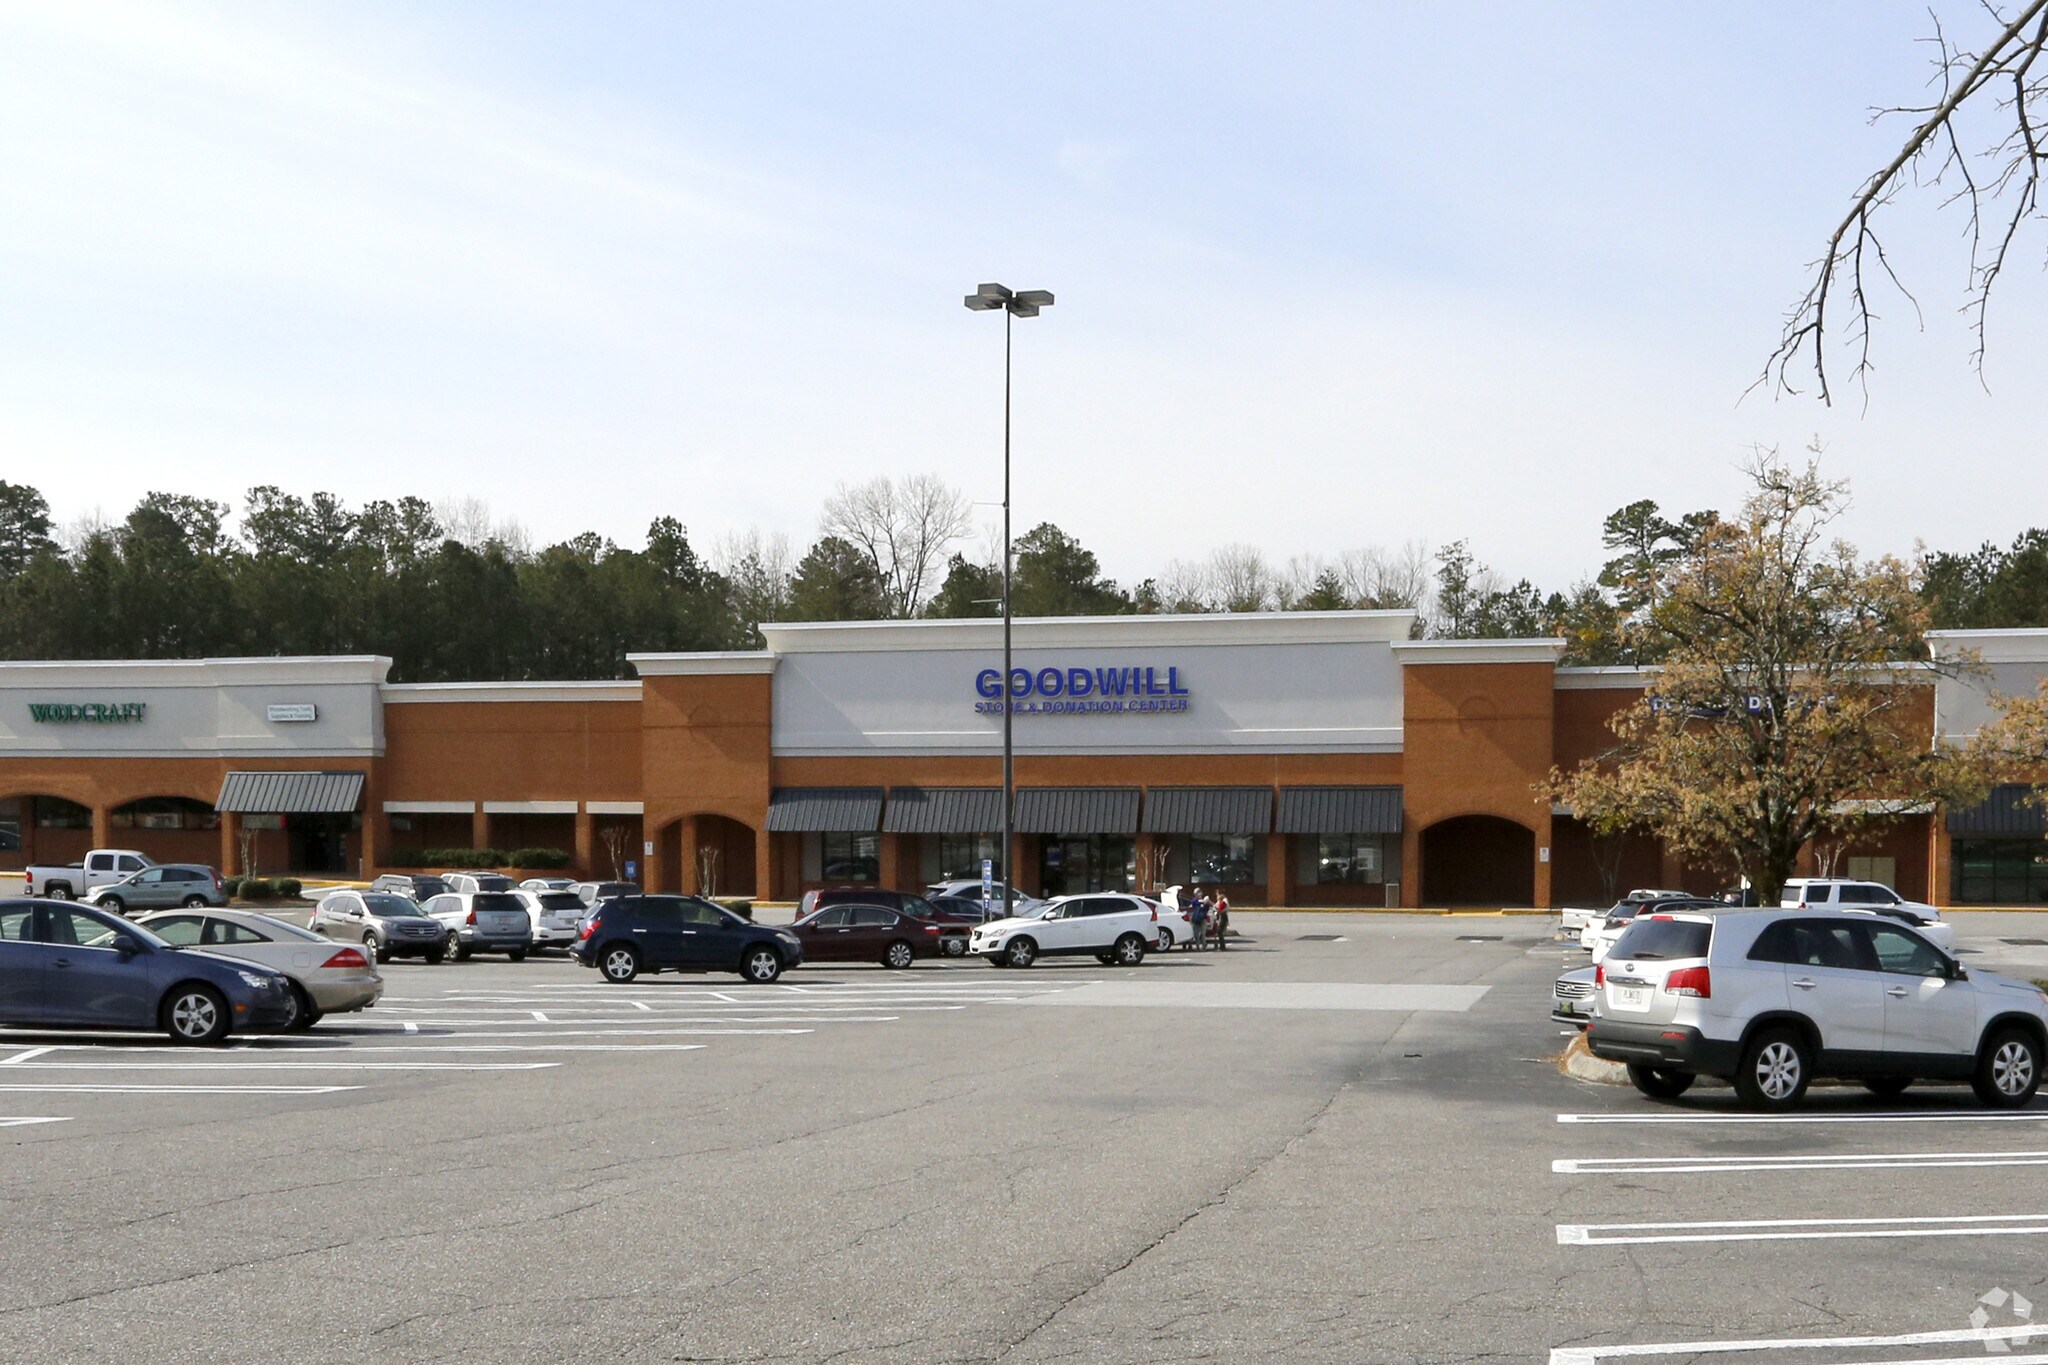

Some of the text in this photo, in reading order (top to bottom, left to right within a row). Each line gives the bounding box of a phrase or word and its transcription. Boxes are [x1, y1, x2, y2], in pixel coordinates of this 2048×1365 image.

[975, 667, 1189, 698] GOODWILL
[27, 703, 146, 722] WOODCRAFT
[975, 700, 1189, 714] STOE & DONATION CENTER
